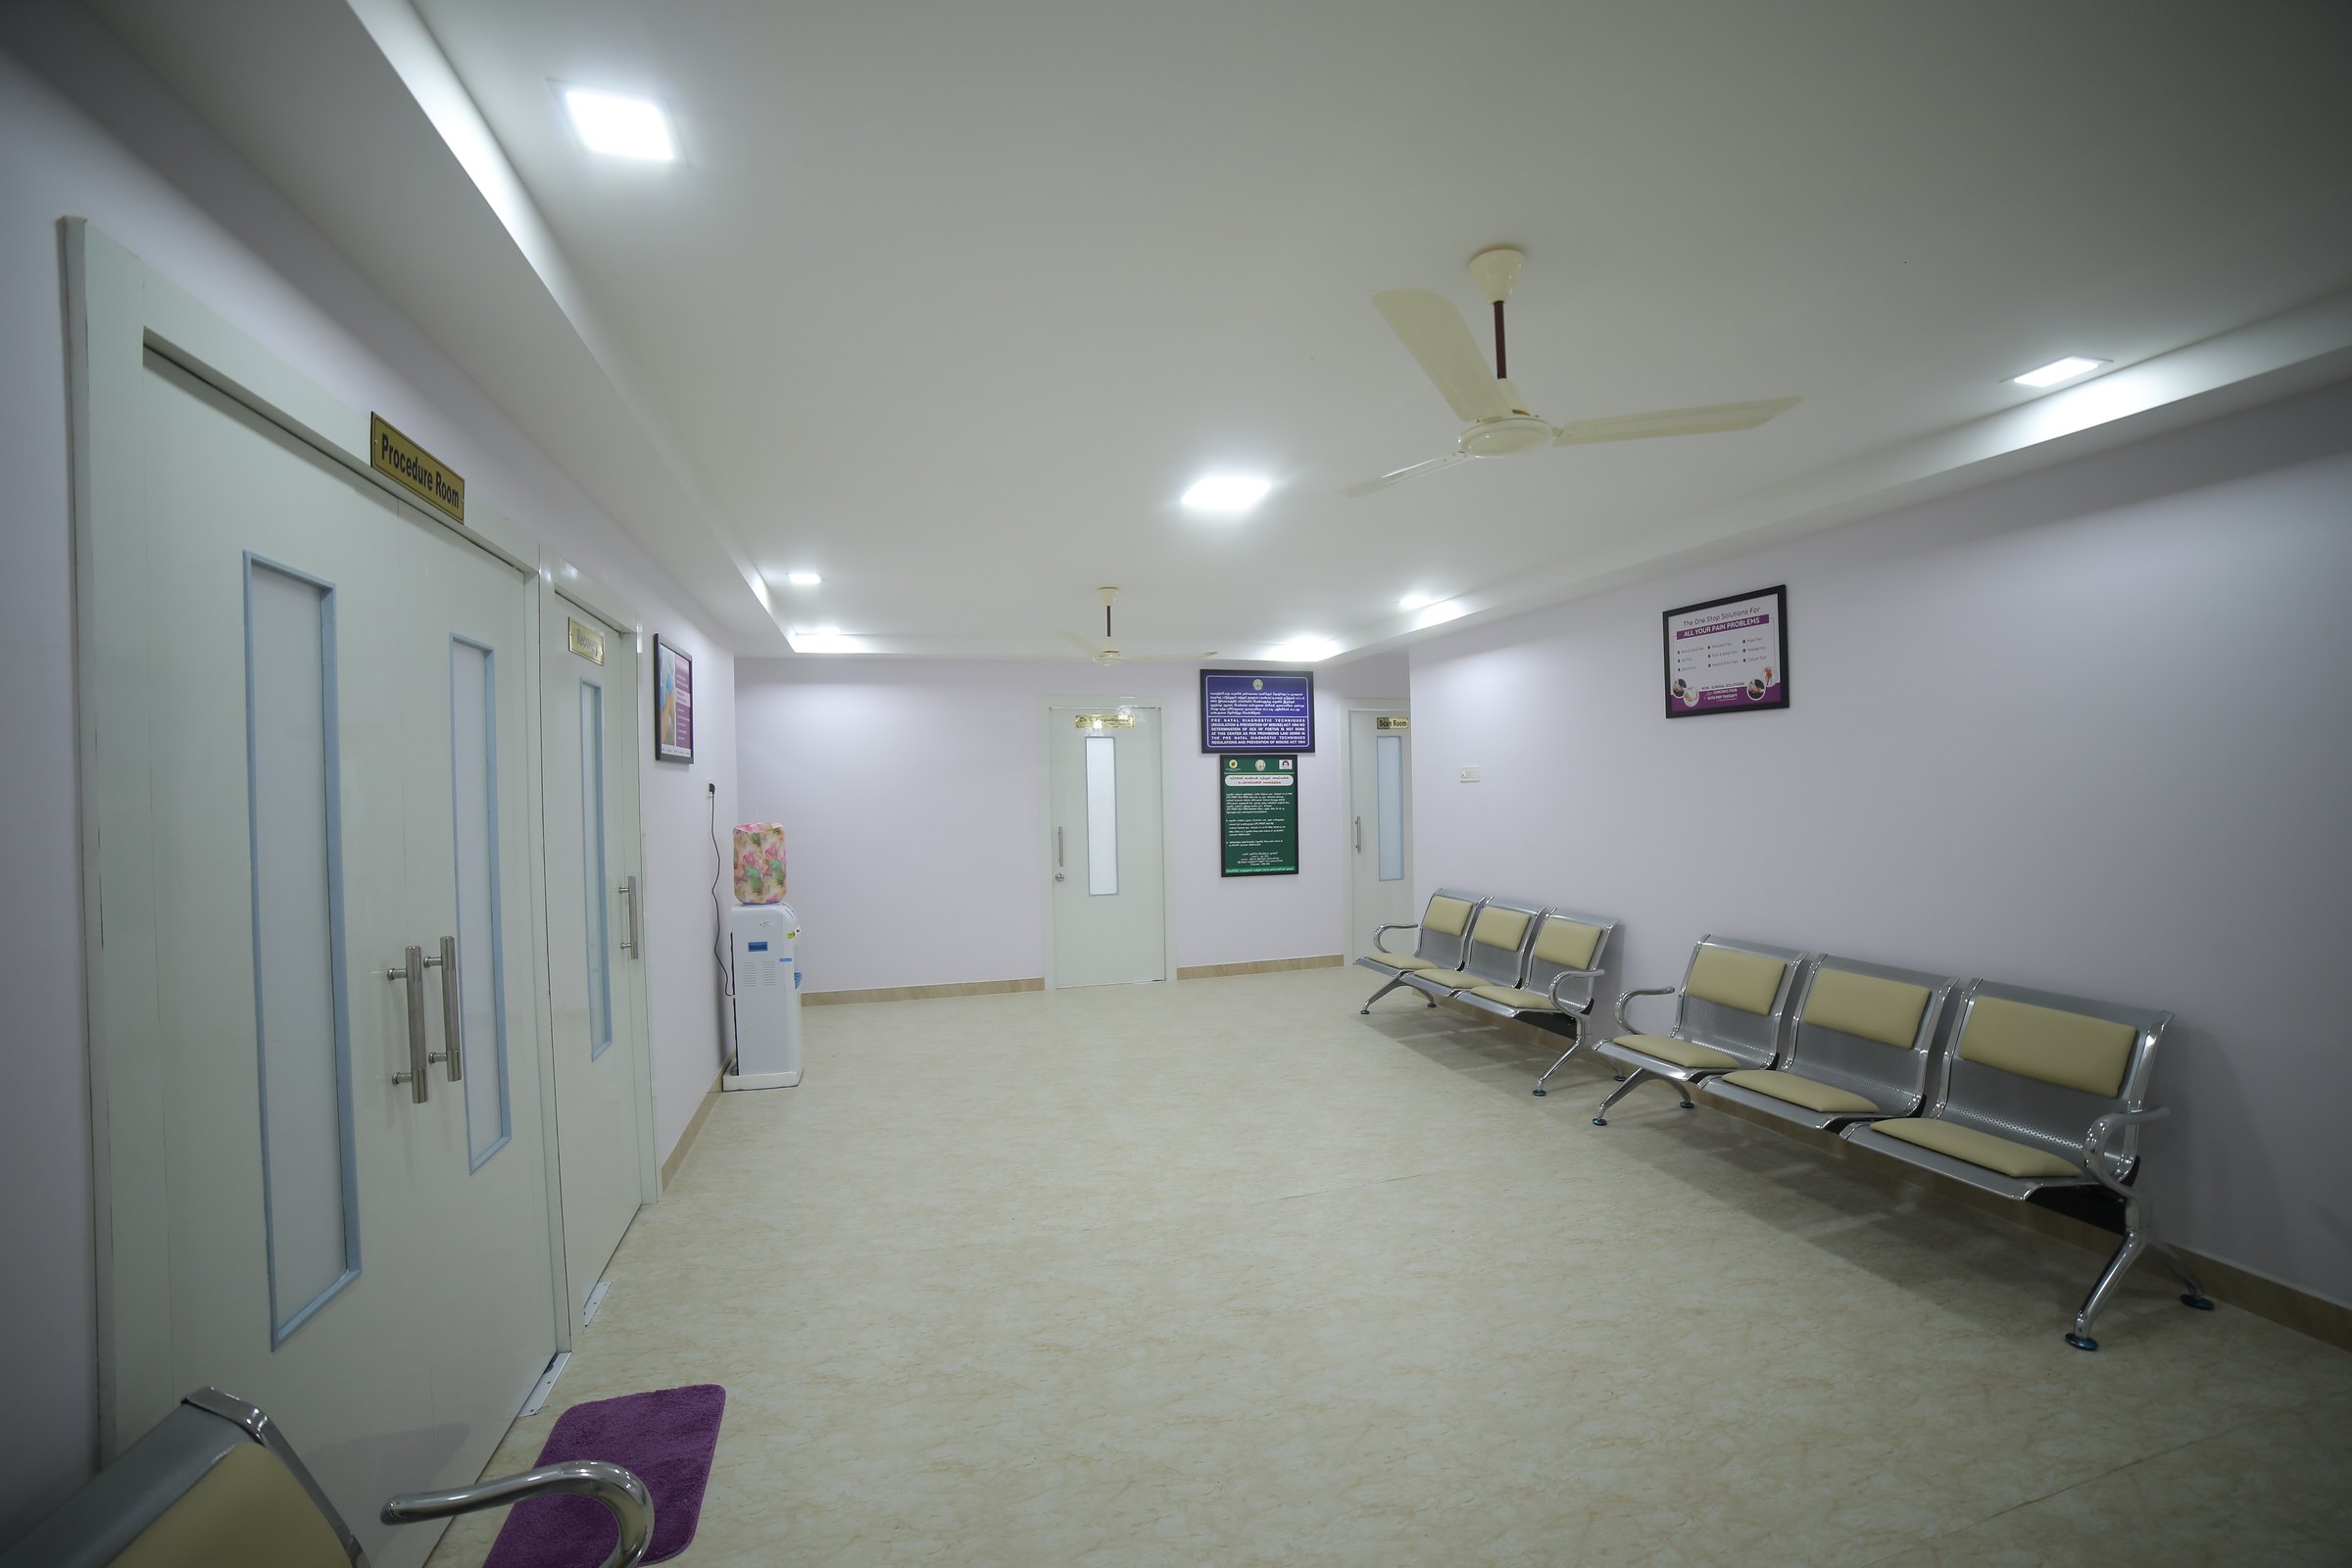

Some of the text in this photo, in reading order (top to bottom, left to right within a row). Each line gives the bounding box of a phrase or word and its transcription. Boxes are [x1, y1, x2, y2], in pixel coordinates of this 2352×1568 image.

[382, 433, 459, 508] Procedure Room
[1695, 625, 1711, 634] YOUR
[1712, 622, 1726, 631] PAIN
[1727, 617, 1760, 629] PROBLEMS
[1707, 615, 1720, 624] Stop
[1722, 611, 1748, 619] Solutions
